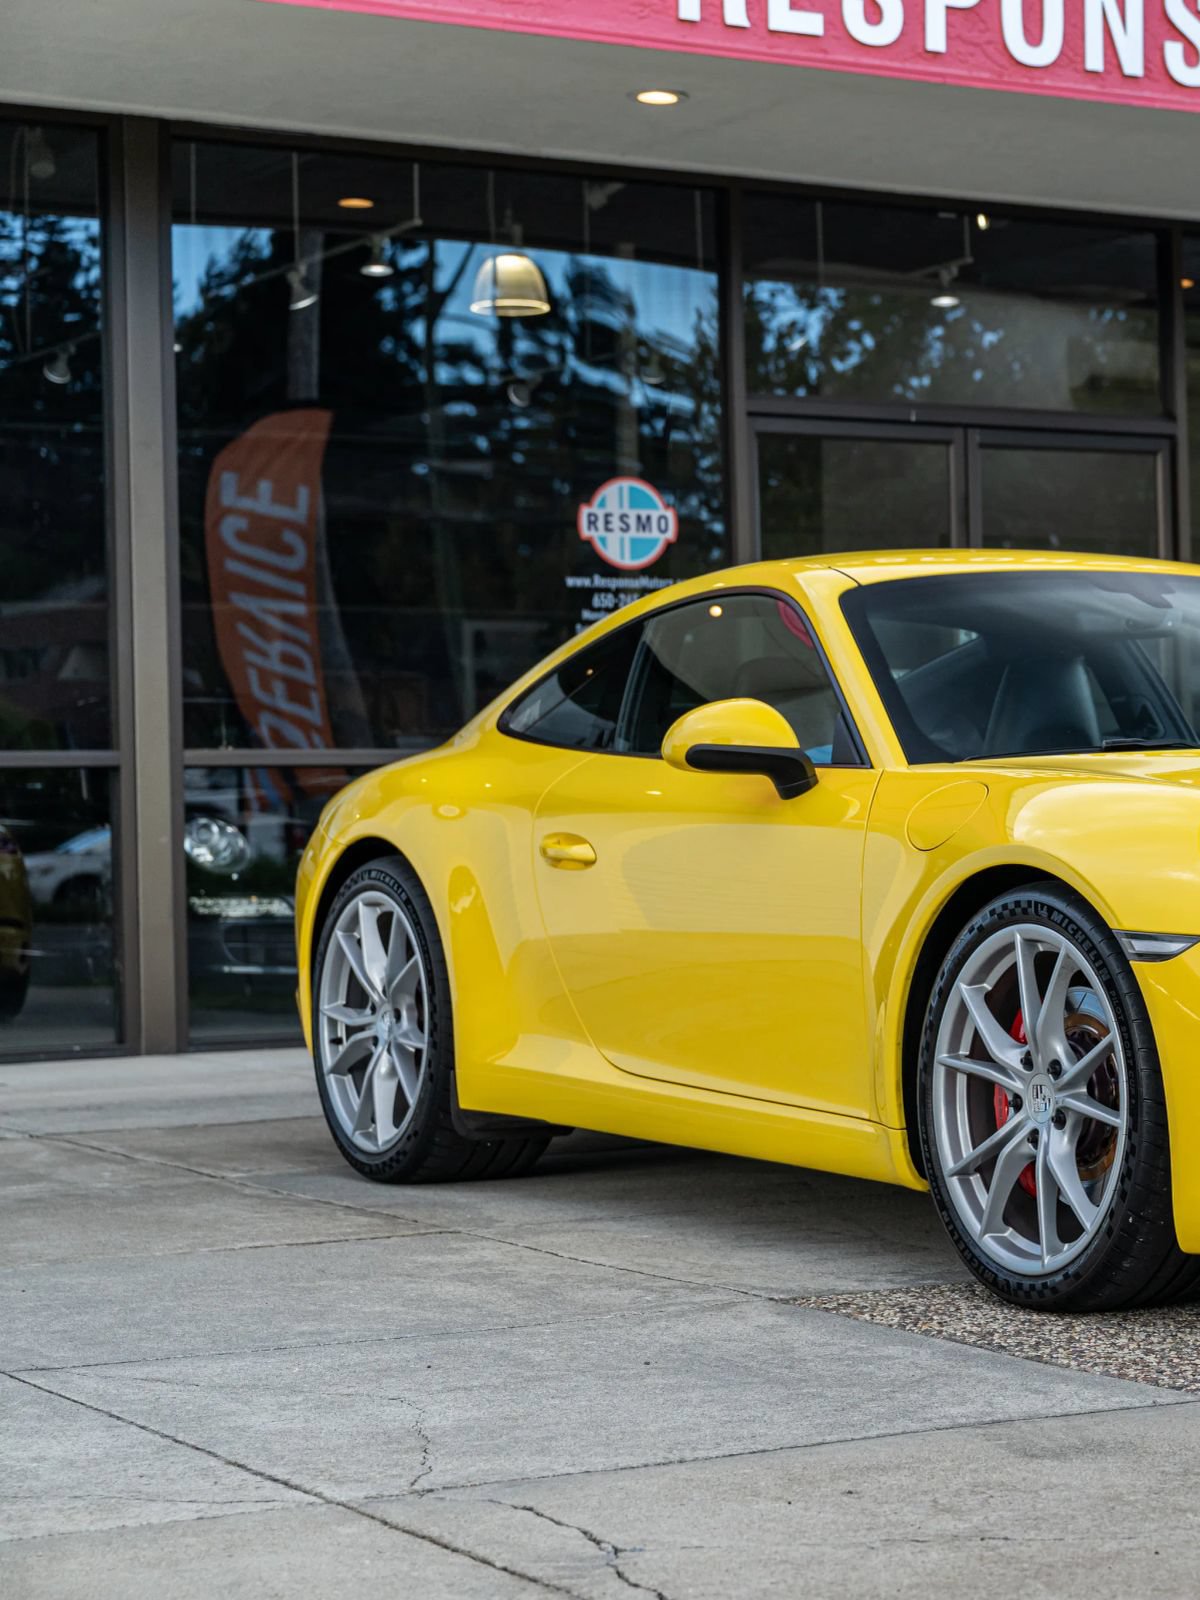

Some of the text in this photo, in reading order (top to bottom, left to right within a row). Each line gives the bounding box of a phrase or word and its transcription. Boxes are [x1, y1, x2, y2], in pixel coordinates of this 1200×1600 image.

[586, 512, 670, 535] RESMO
[565, 574, 688, 591] www.ResponseMotors
[1050, 910, 1111, 981] MICHELIN
